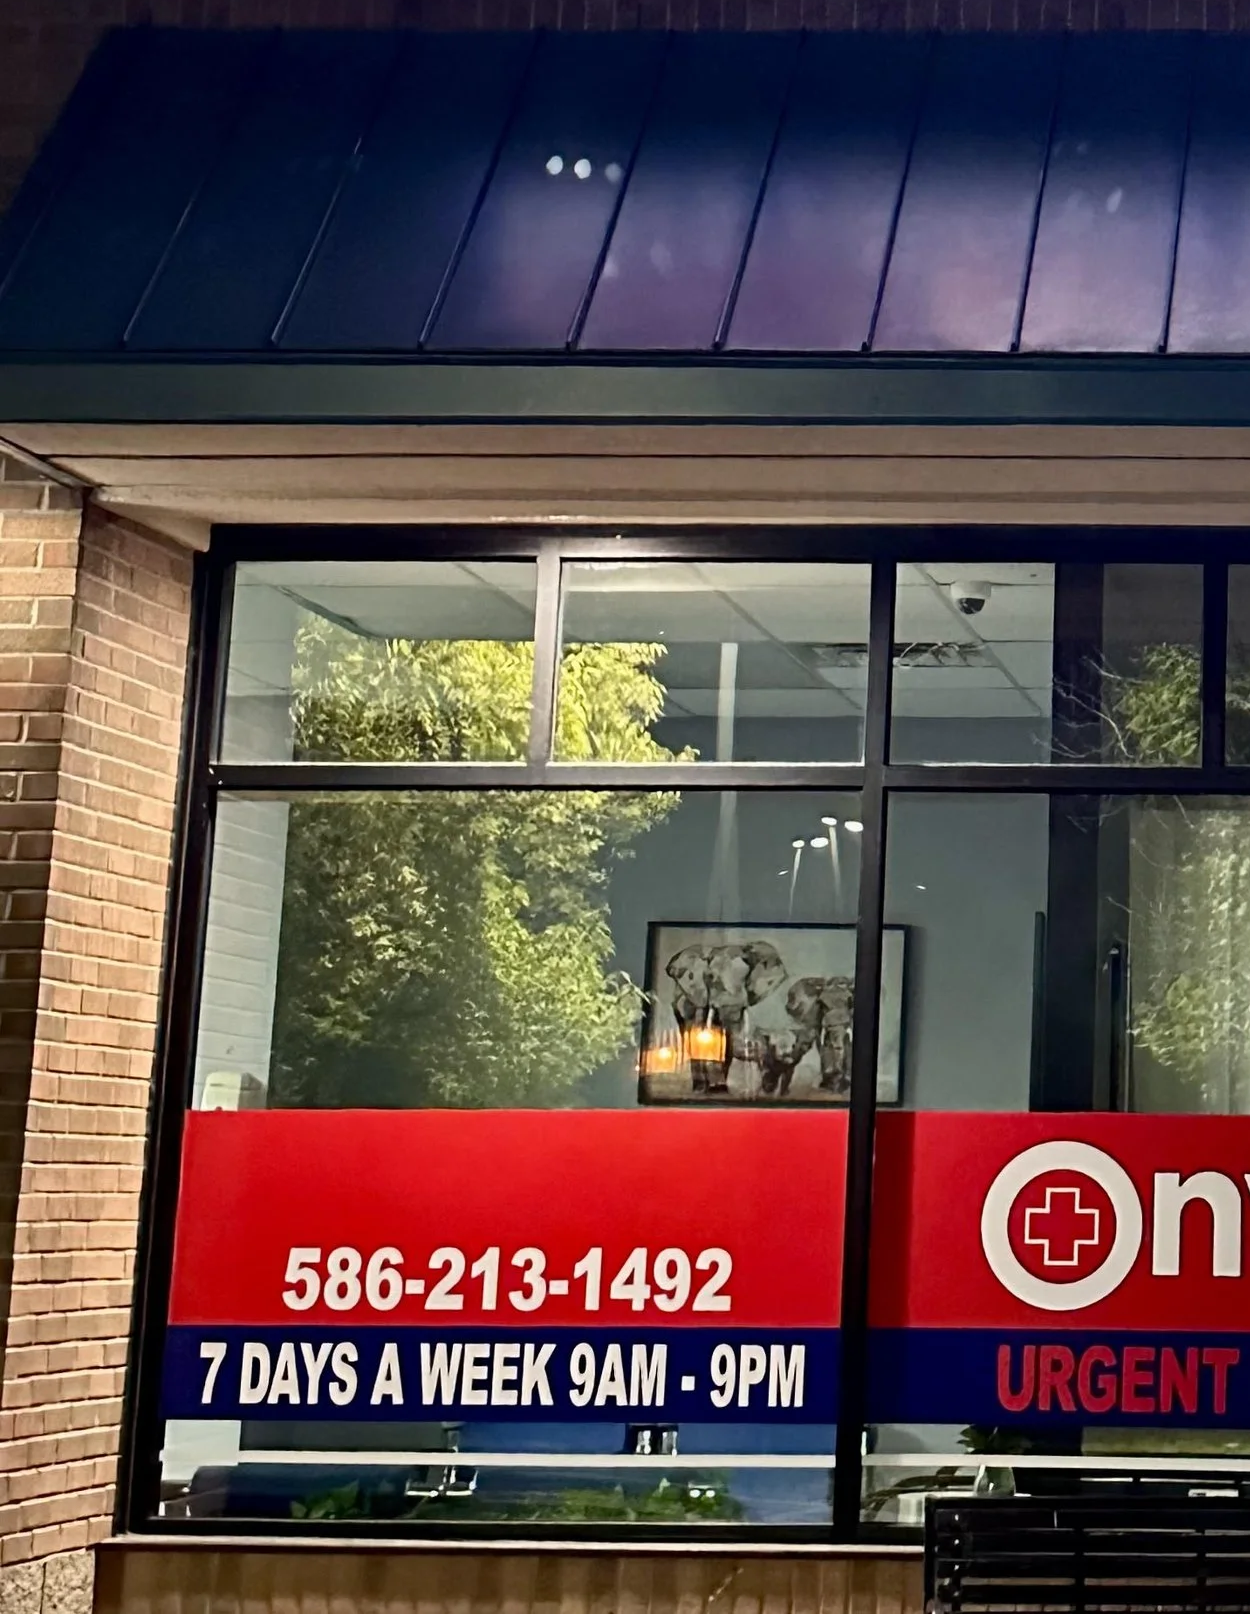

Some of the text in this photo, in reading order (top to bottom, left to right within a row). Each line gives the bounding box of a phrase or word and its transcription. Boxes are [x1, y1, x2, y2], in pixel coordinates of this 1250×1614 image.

[281, 1246, 734, 1312] 586-213-1492
[199, 1342, 228, 1405] 7
[239, 1342, 359, 1406] DAYS
[370, 1343, 403, 1406] A
[419, 1343, 556, 1406] WEEK
[568, 1343, 668, 1408] 9AM
[709, 1344, 806, 1408] 9PM
[996, 1344, 1240, 1414] URGENT
